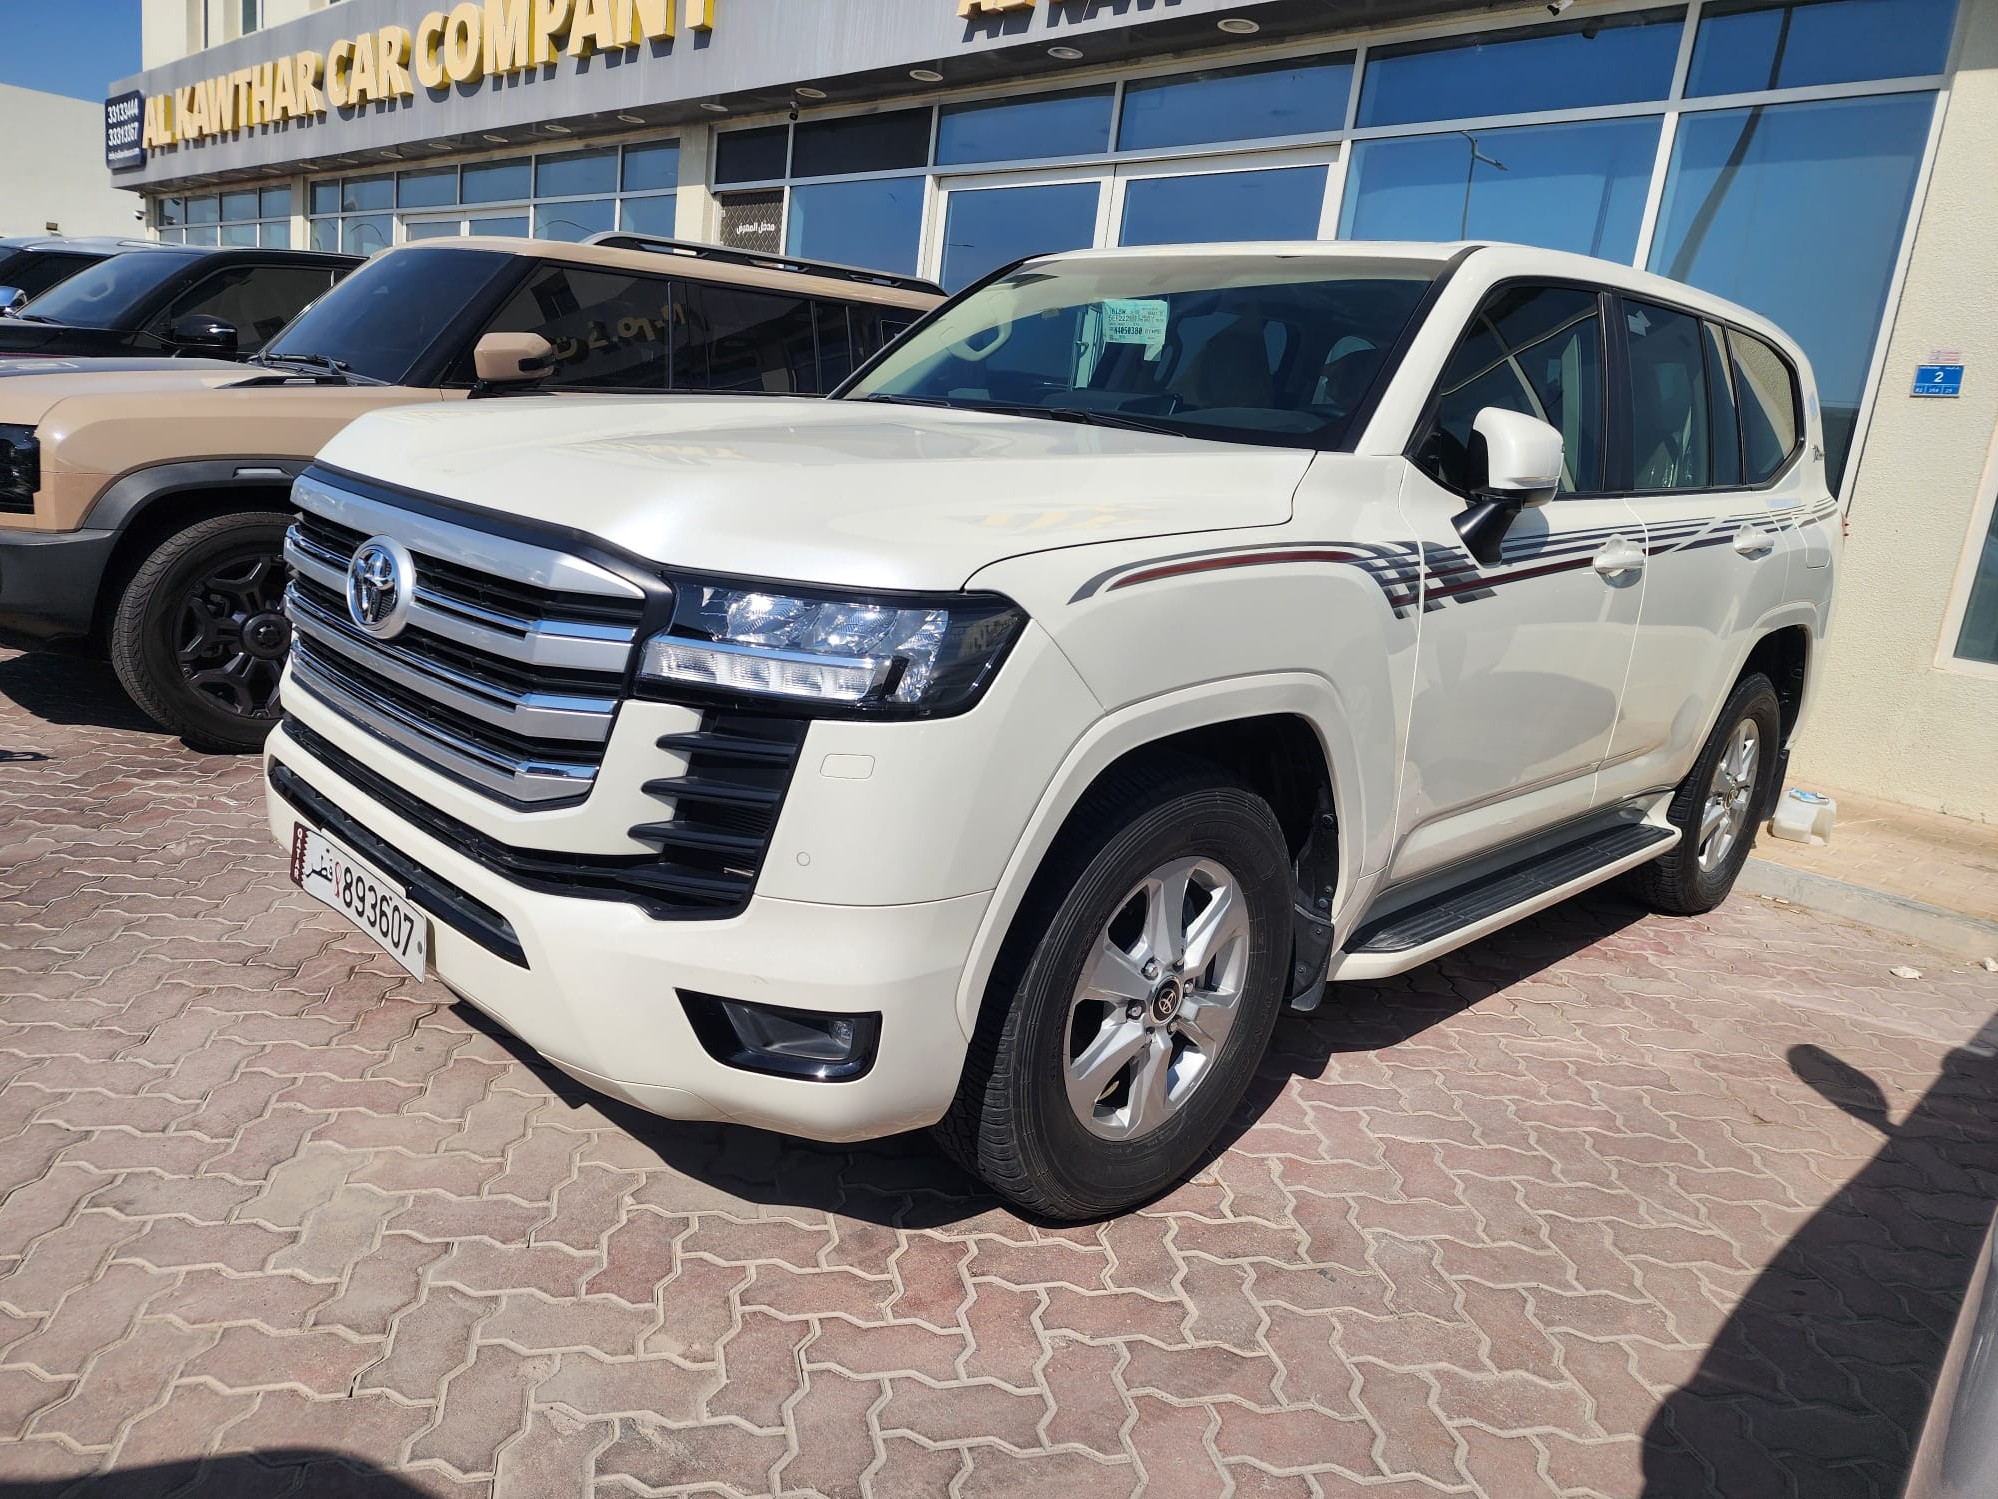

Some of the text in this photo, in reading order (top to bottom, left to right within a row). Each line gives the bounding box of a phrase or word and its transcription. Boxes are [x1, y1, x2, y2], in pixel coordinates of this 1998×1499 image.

[142, 0, 714, 149] AL KAWTHAR CAR COMPA
[736, 220, 775, 235] مدخل المعرض
[1933, 371, 1944, 383] 2
[294, 828, 303, 880] QATAR
[305, 848, 333, 883] قطر
[342, 866, 414, 957] 893607
